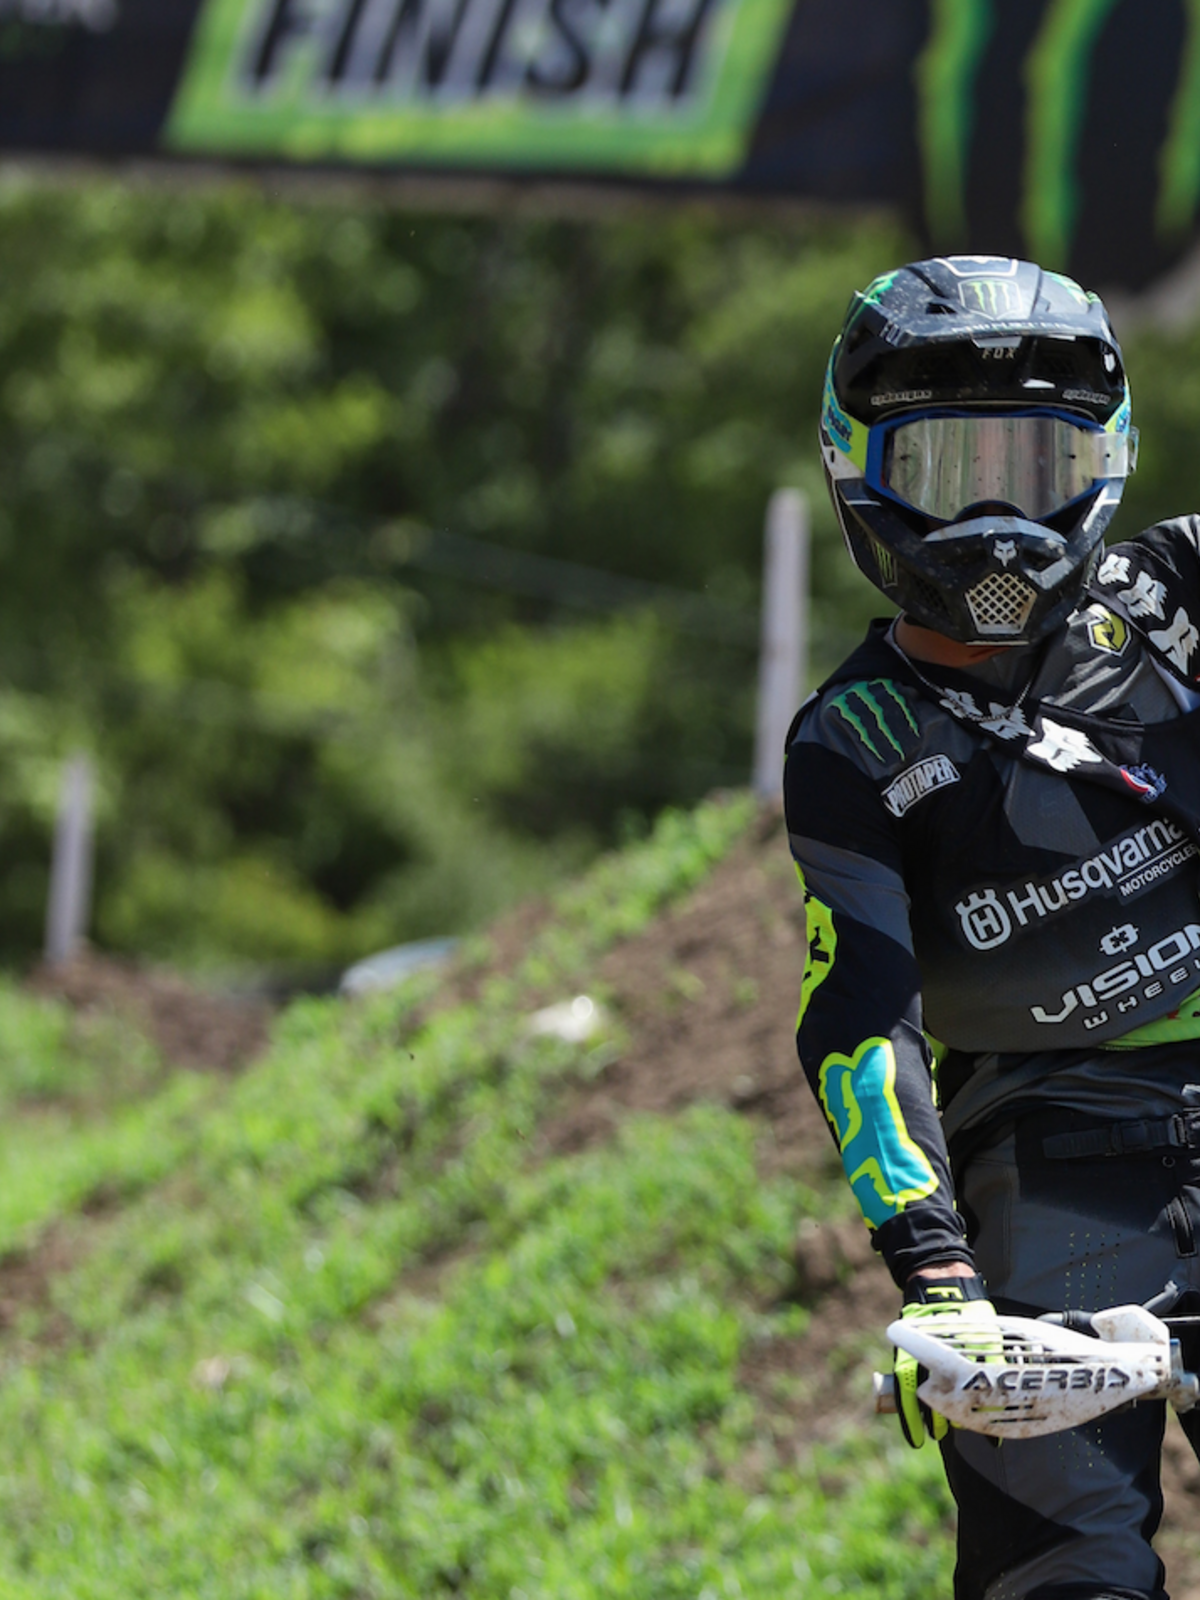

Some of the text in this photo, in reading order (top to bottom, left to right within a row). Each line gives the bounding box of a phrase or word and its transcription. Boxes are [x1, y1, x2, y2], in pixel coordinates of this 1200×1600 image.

[246, 0, 716, 104] FINISH
[981, 347, 1016, 360] FOX
[1118, 843, 1197, 897] MOTORCYCLES
